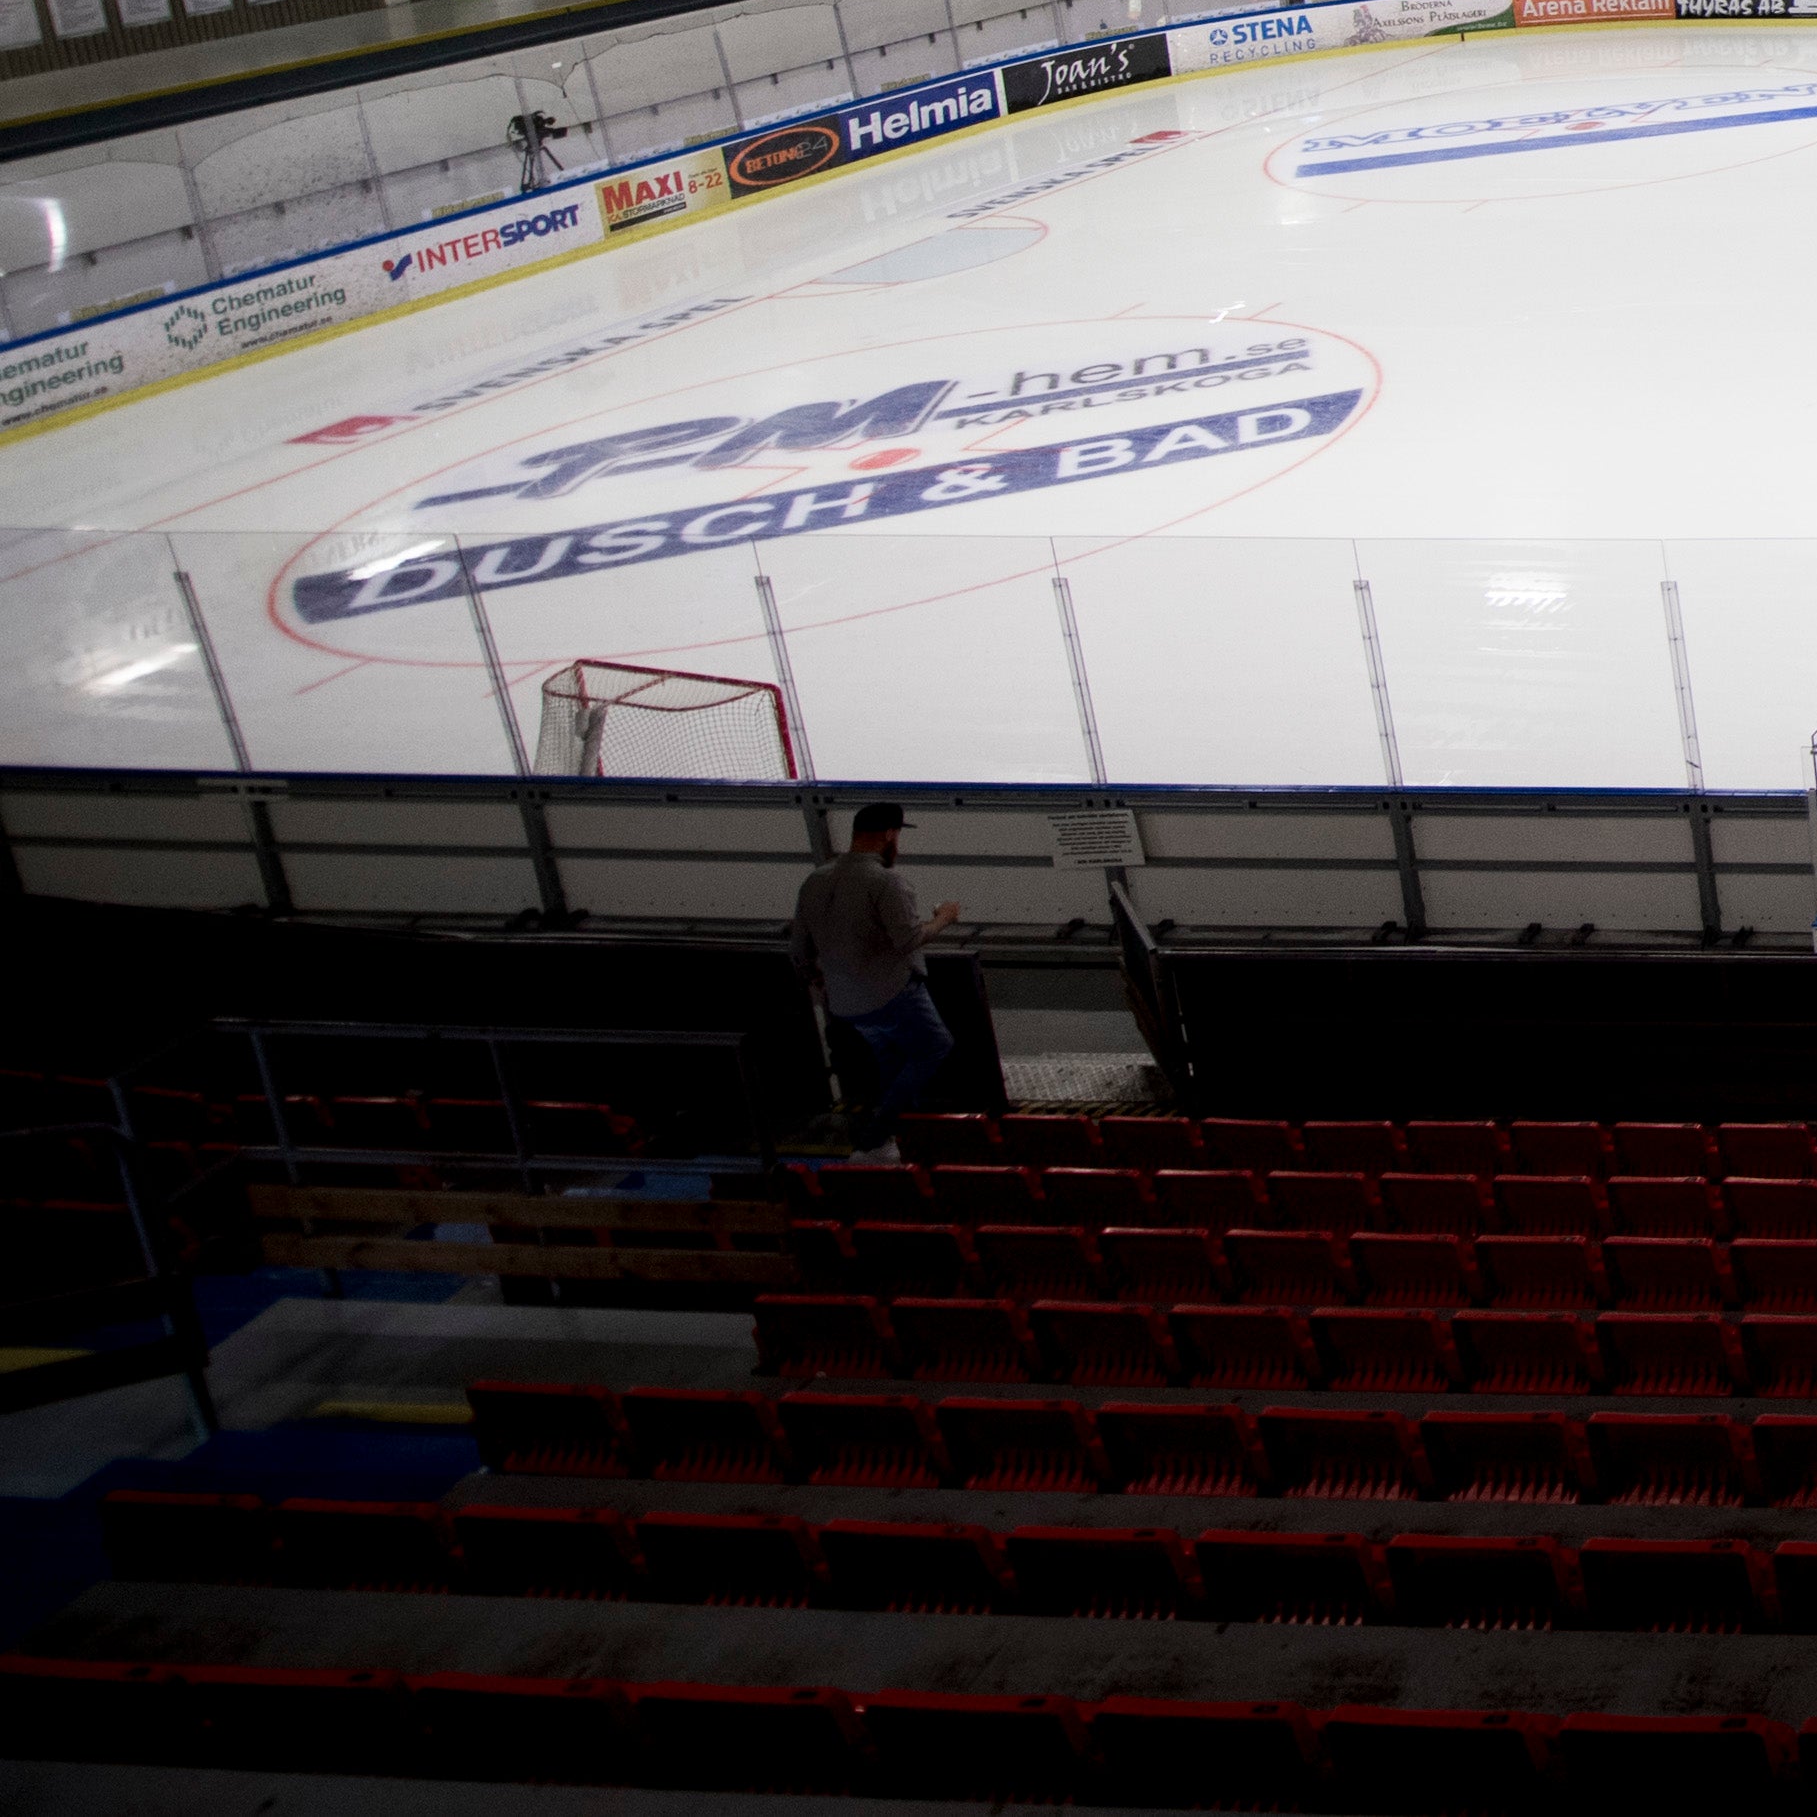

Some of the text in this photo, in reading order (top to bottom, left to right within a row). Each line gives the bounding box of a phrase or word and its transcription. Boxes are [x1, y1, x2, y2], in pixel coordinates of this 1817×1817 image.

[1210, 37, 1317, 65] RECYCLING
[1233, 15, 1313, 45] STENA
[1037, 41, 1132, 106] Joan's
[848, 85, 993, 152] Helmia
[602, 168, 723, 215] MAXI 8-22
[945, 167, 1096, 220] SVENSKA
[416, 203, 581, 274] INTERSPORT
[210, 273, 317, 317] Chematur
[217, 285, 347, 339] Engineering
[412, 295, 748, 414] SVENSKA SPEL
[953, 359, 1313, 432] KARLSKOGA
[345, 403, 1316, 612] DUSCH & BAD
